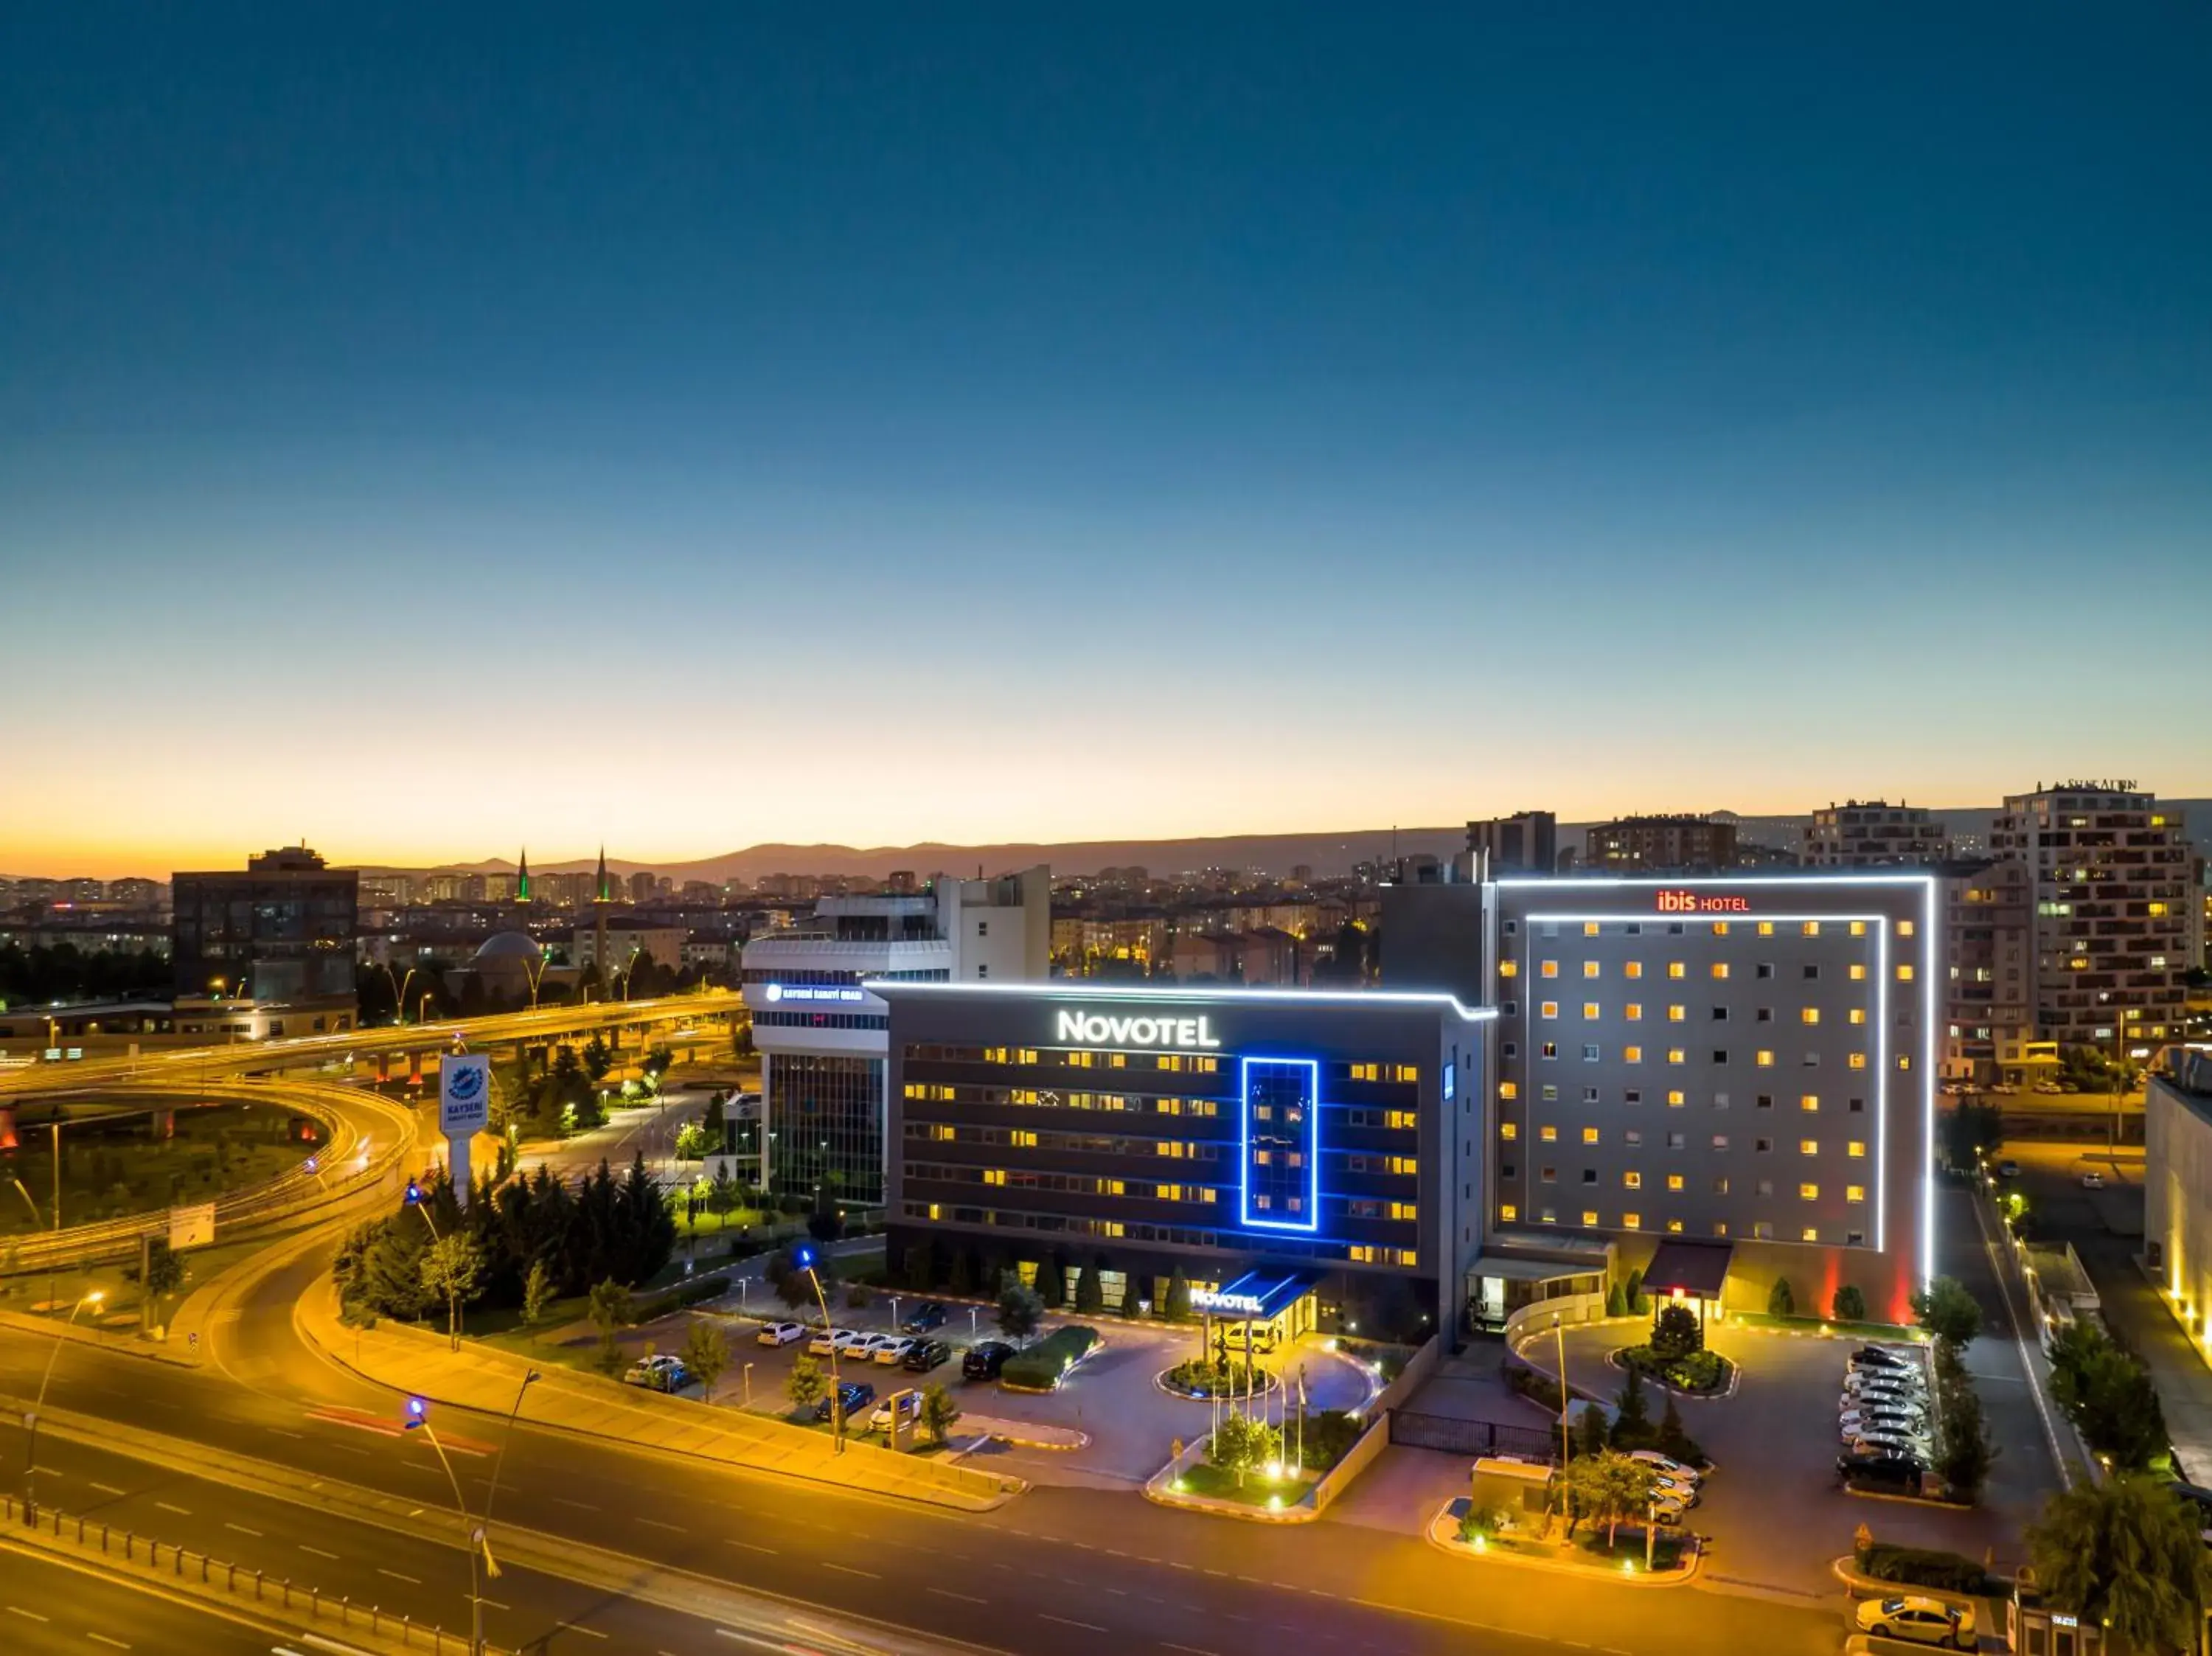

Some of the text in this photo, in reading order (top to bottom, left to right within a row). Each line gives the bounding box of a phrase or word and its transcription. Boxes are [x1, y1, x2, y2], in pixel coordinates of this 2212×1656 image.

[1658, 890, 1750, 911] ibis HOTEL
[1058, 1010, 1220, 1046] NOVOTEL
[1190, 1289, 1263, 1312] NOVOTEL
